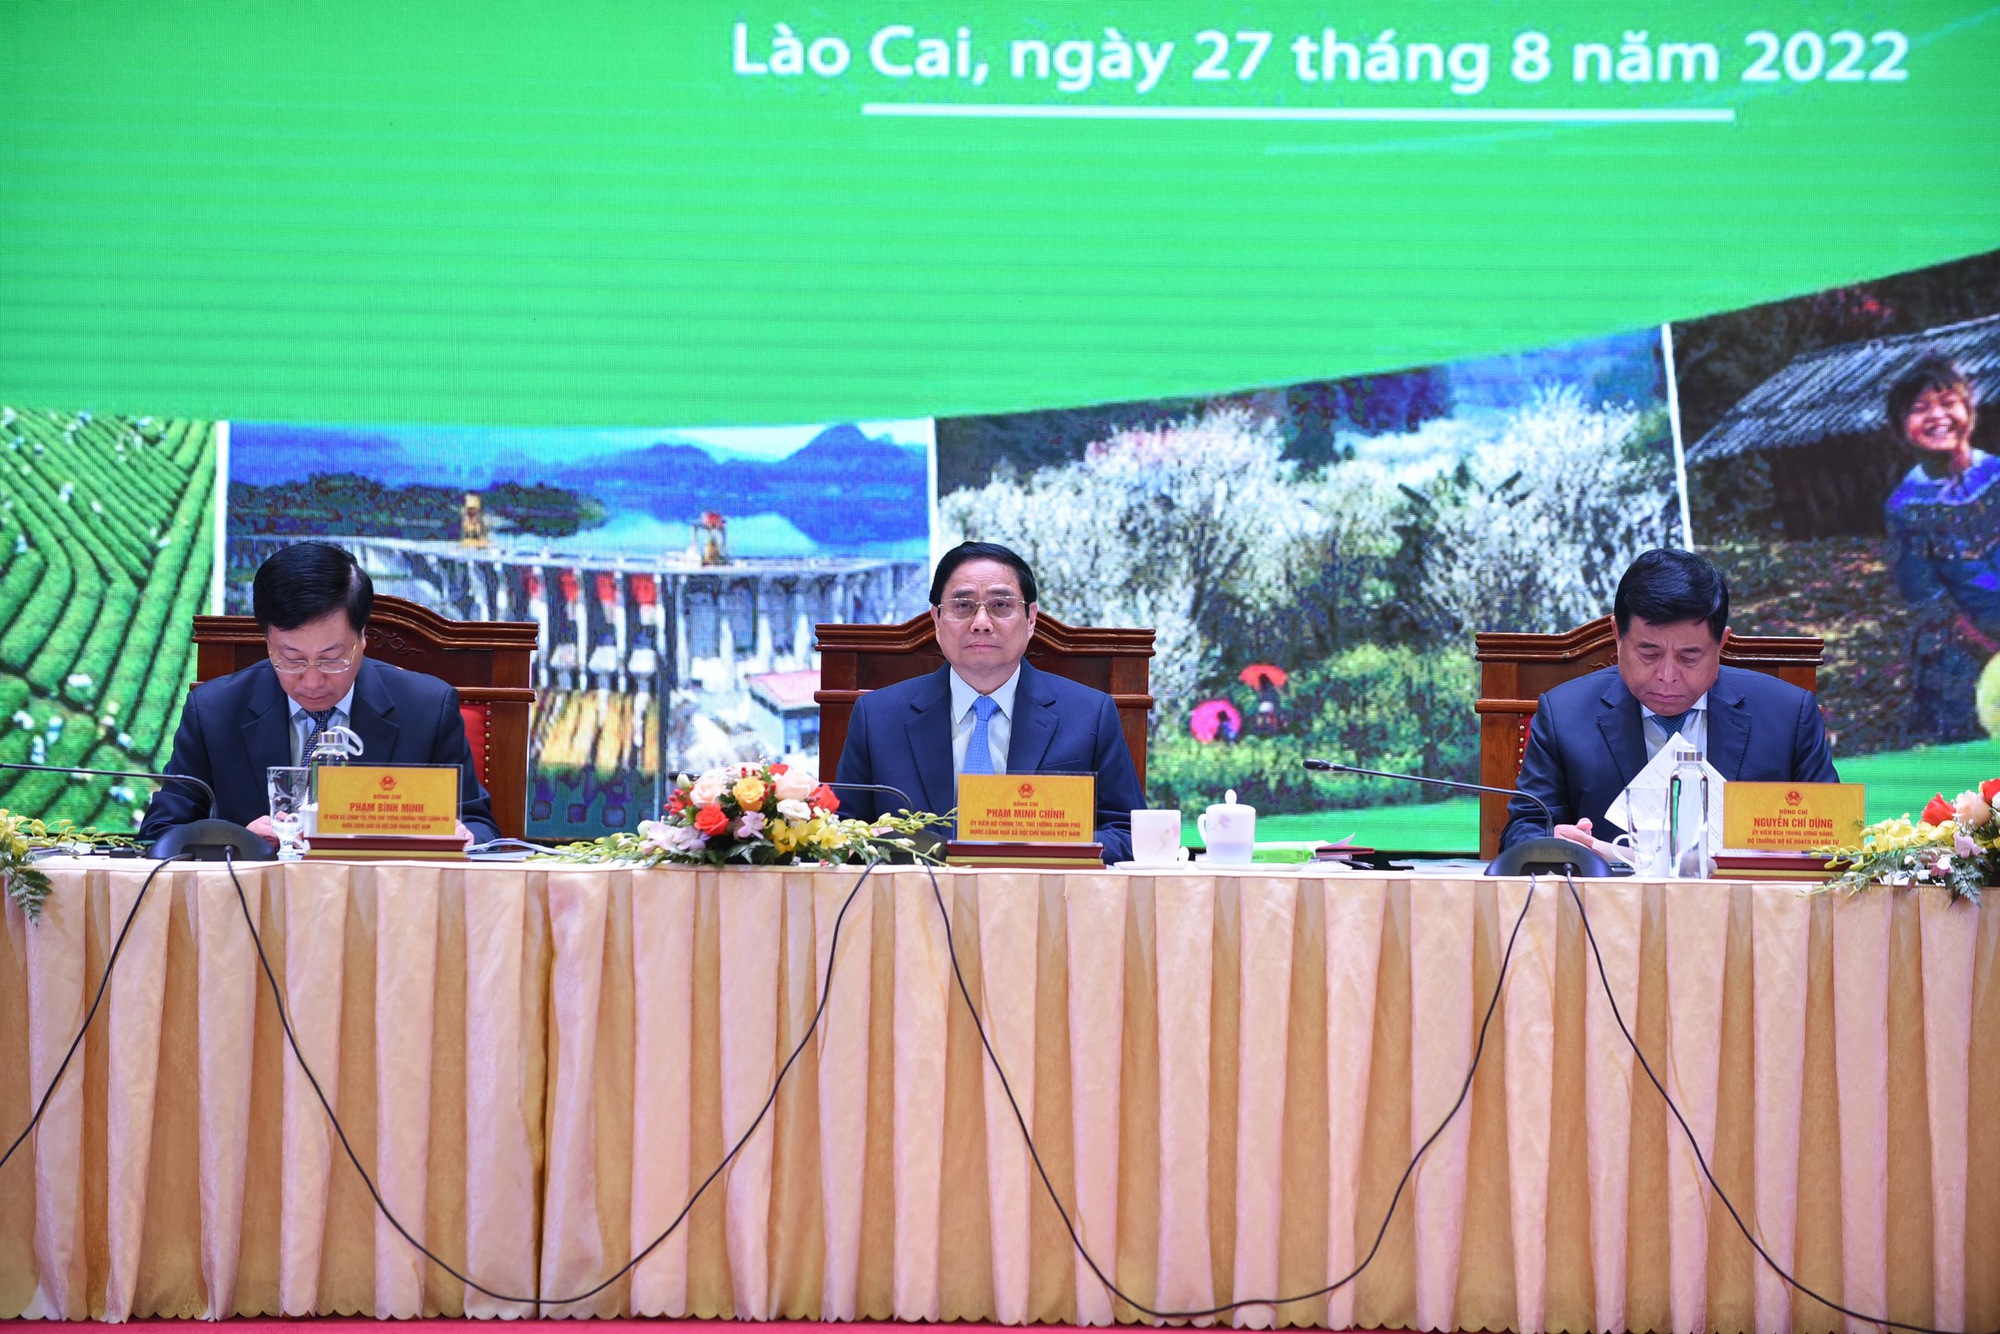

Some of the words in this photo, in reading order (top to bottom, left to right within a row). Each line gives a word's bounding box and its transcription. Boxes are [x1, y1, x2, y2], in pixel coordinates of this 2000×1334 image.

[735, 23, 850, 75] Lào
[871, 26, 988, 84] Cai,
[1011, 28, 1173, 92] ngày
[1193, 31, 1271, 79] 27
[1291, 29, 1488, 94] tháng
[1511, 33, 1550, 81] 8
[1573, 32, 1718, 81] năm
[1742, 32, 1906, 80] 2022
[350, 802, 375, 813] PHẠM
[378, 802, 398, 812] BÌNH
[401, 803, 424, 813] MINH
[986, 809, 1011, 820] PHẠM
[1014, 809, 1036, 818] MINH
[1039, 808, 1065, 819] CHÍNH
[1754, 815, 1789, 827] NGUYỄN
[1792, 817, 1806, 828] CHÍ
[1809, 817, 1833, 828] DŨNG
